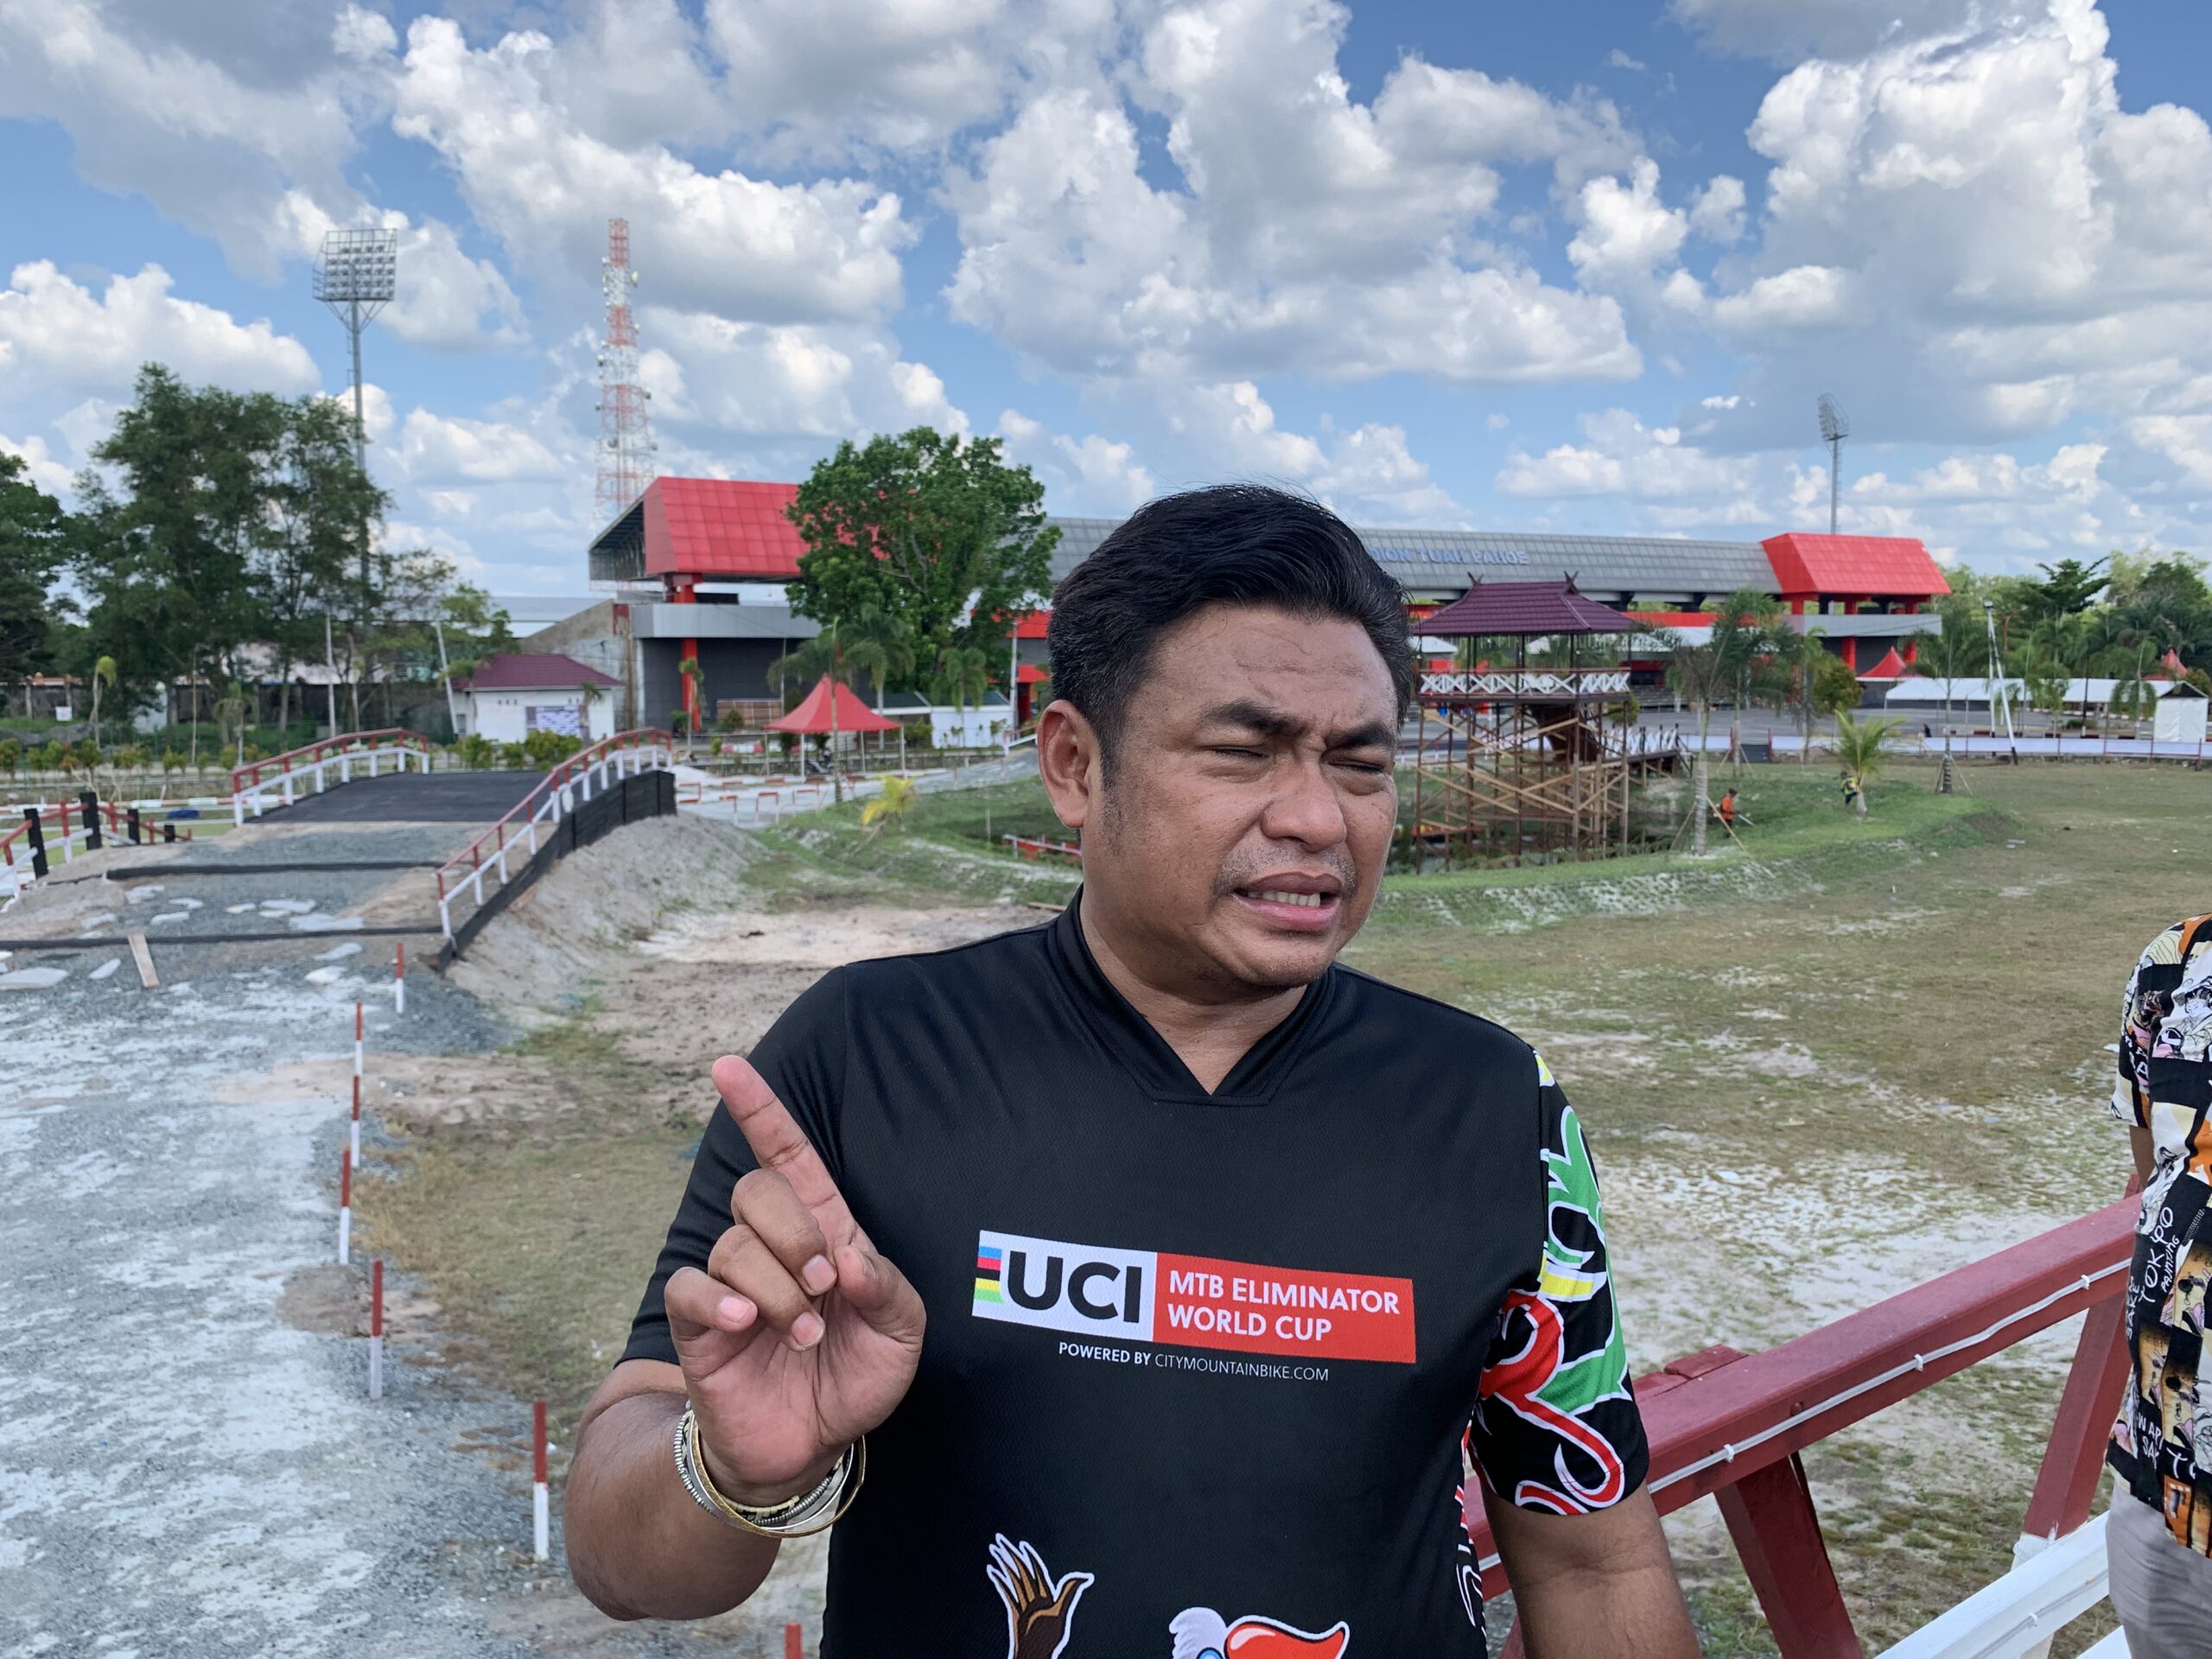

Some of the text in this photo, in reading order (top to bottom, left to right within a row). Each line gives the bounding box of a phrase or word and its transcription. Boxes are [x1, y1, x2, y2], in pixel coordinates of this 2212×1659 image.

[1416, 548, 1468, 564] TUAH
[1007, 1250, 1142, 1324] UCI
[1169, 1269, 1401, 1315] MTB ELIMINATOR
[1166, 1304, 1332, 1342] WORLD CUP
[1058, 1341, 1330, 1382] POWERED BY CITYMOUNTAINBIKE.COM
